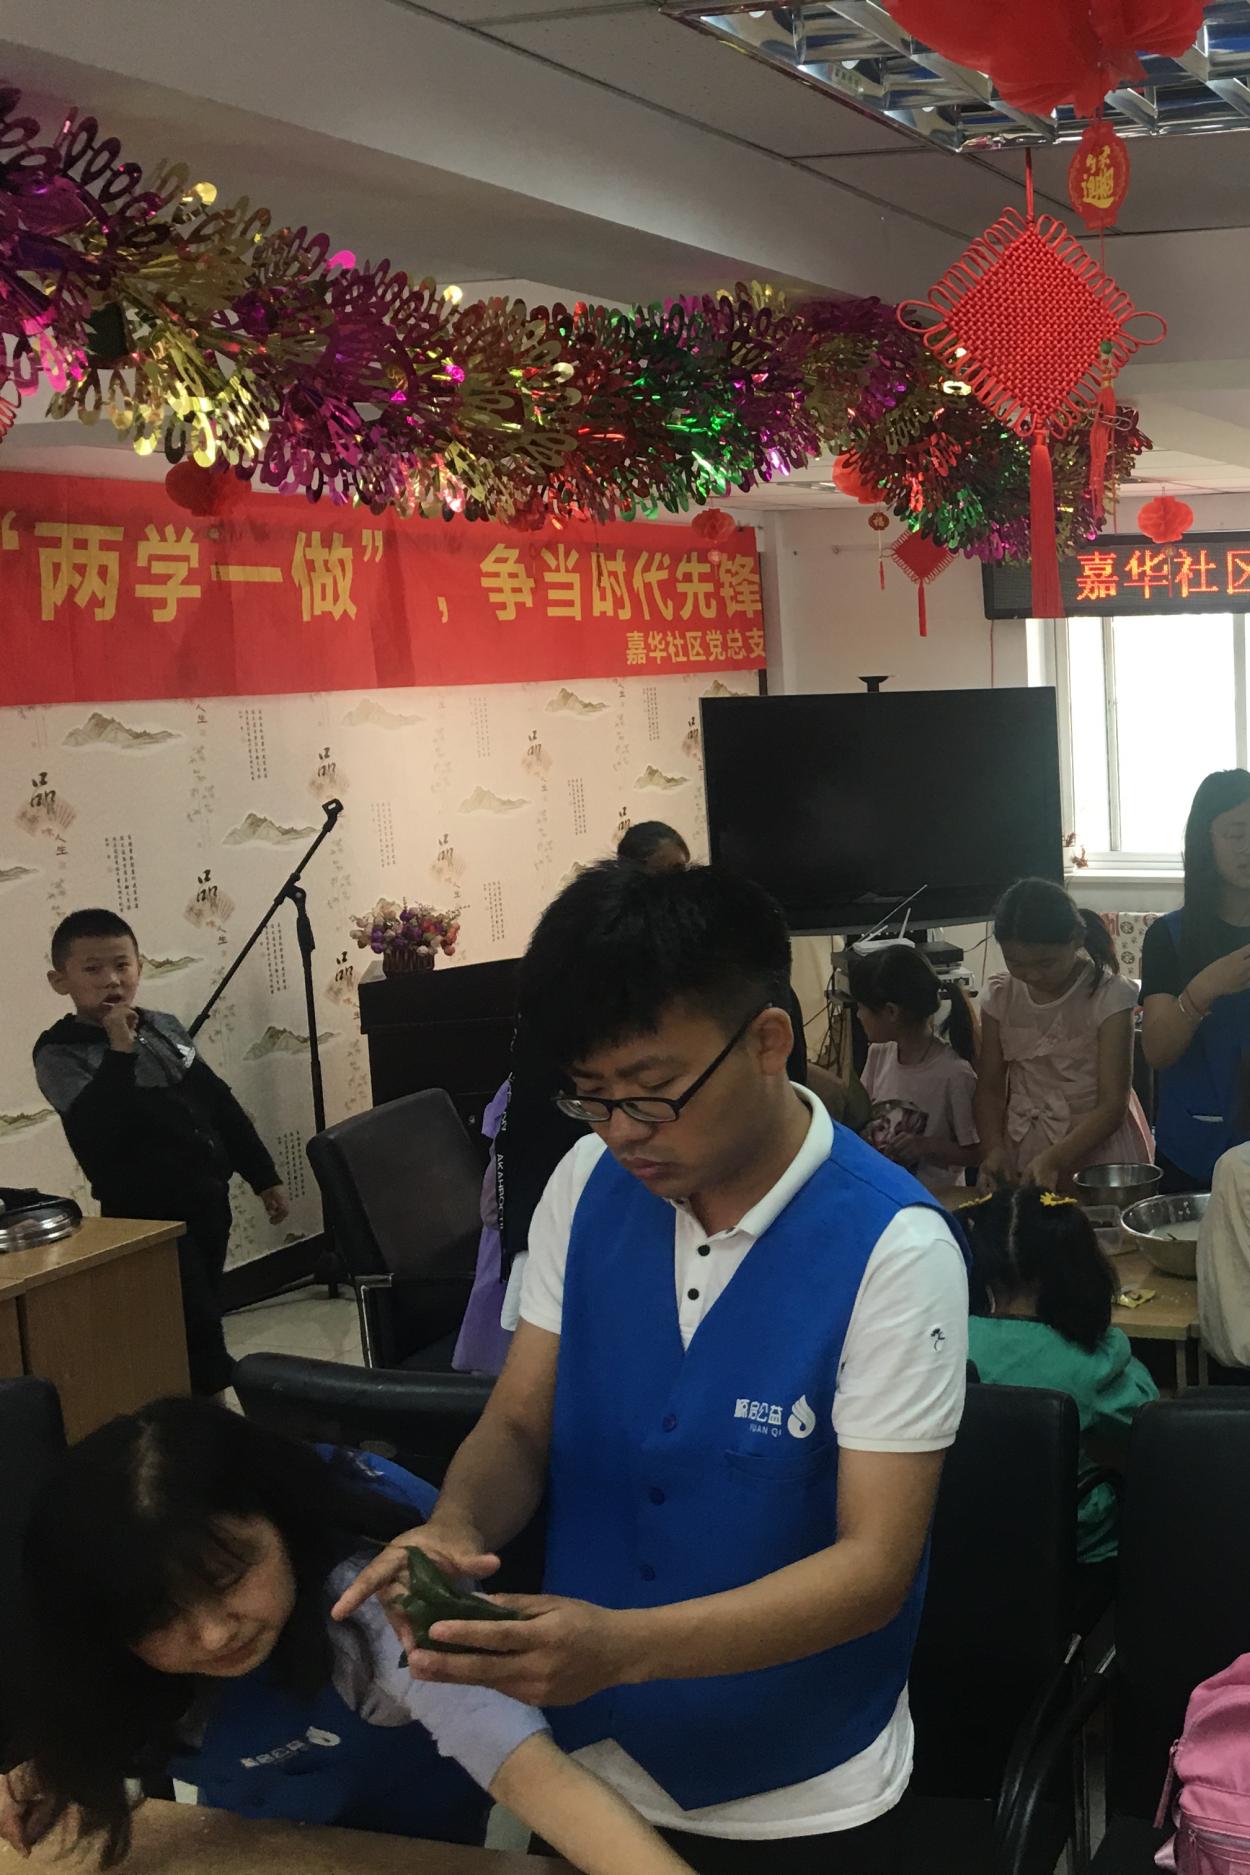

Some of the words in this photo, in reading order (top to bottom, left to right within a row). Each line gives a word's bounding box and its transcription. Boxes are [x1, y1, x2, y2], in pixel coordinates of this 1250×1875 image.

[626, 629, 766, 665] 嘉华社区党总支
